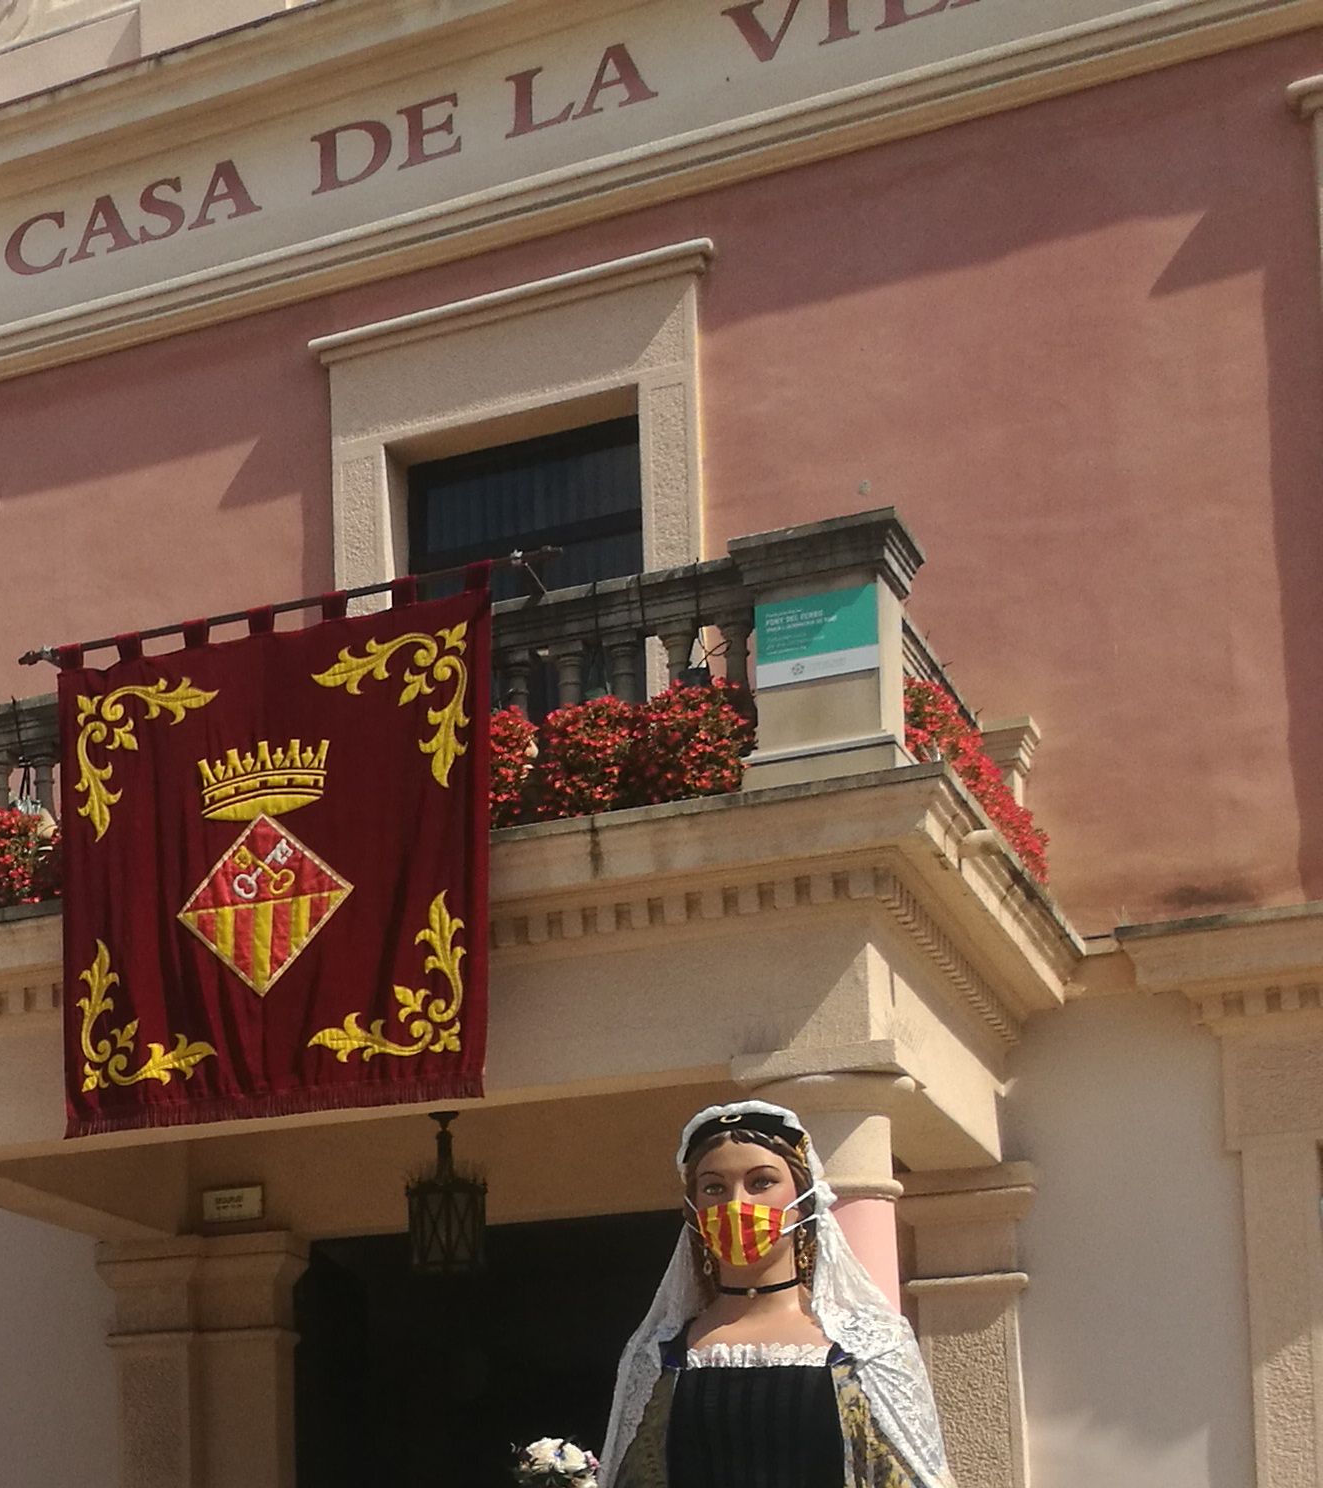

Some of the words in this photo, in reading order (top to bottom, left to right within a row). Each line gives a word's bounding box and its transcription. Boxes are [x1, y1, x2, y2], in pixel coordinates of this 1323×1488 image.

[4, 159, 262, 276] CASA
[310, 94, 462, 196] DE
[504, 42, 659, 139] LA
